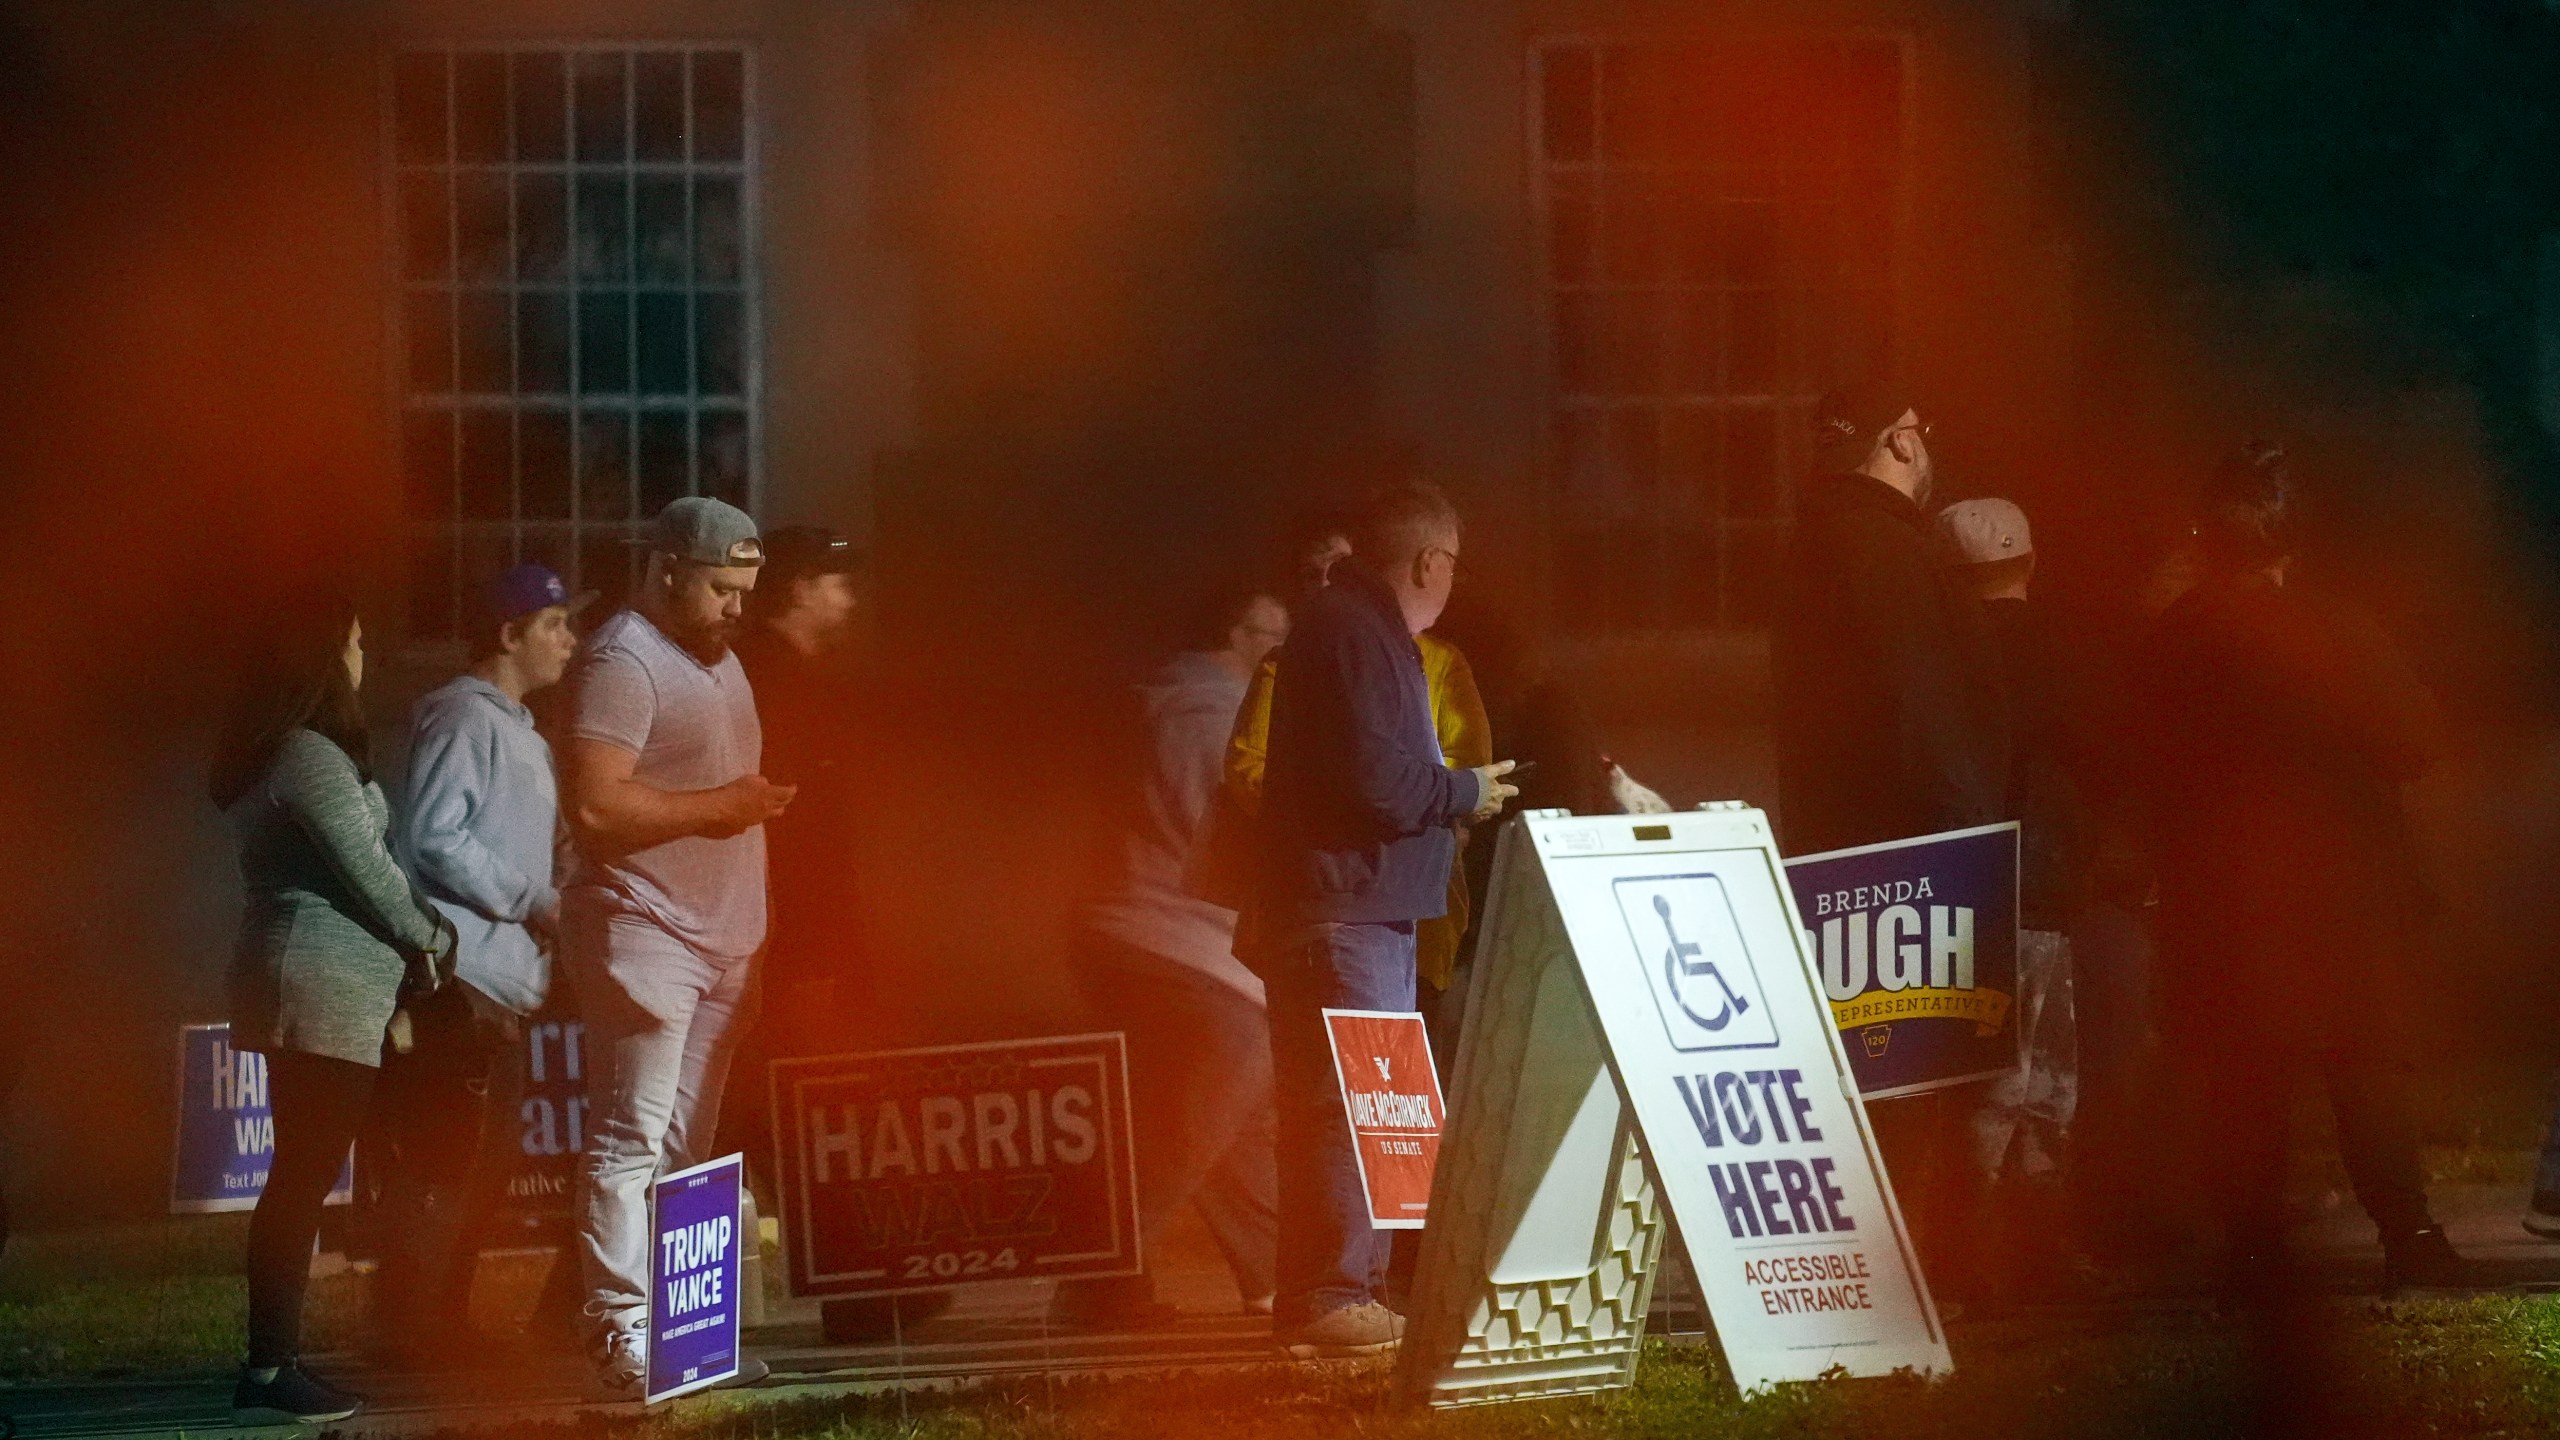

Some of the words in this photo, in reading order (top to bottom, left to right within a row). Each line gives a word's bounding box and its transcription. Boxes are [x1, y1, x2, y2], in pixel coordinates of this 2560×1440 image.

[1816, 876, 1934, 916] BRENDA
[1804, 904, 1974, 1001] UGH
[1868, 1035, 1886, 1047] 120
[1672, 1069, 1823, 1148] VOTE
[811, 1085, 1097, 1183] HARRIS
[1381, 1141, 1393, 1155] US
[1393, 1141, 1423, 1155] SENATE
[222, 1171, 248, 1188] Text
[1707, 1157, 1856, 1238] HERE
[854, 1173, 1057, 1250] WALZ
[662, 1215, 732, 1277] TRUMP
[902, 1246, 1020, 1279] 2024
[1744, 1253, 1870, 1286] ACCESSIBLE
[667, 1267, 722, 1318] VANCE
[1760, 1284, 1872, 1316] ENTRANCE
[683, 1367, 698, 1382] 2024
